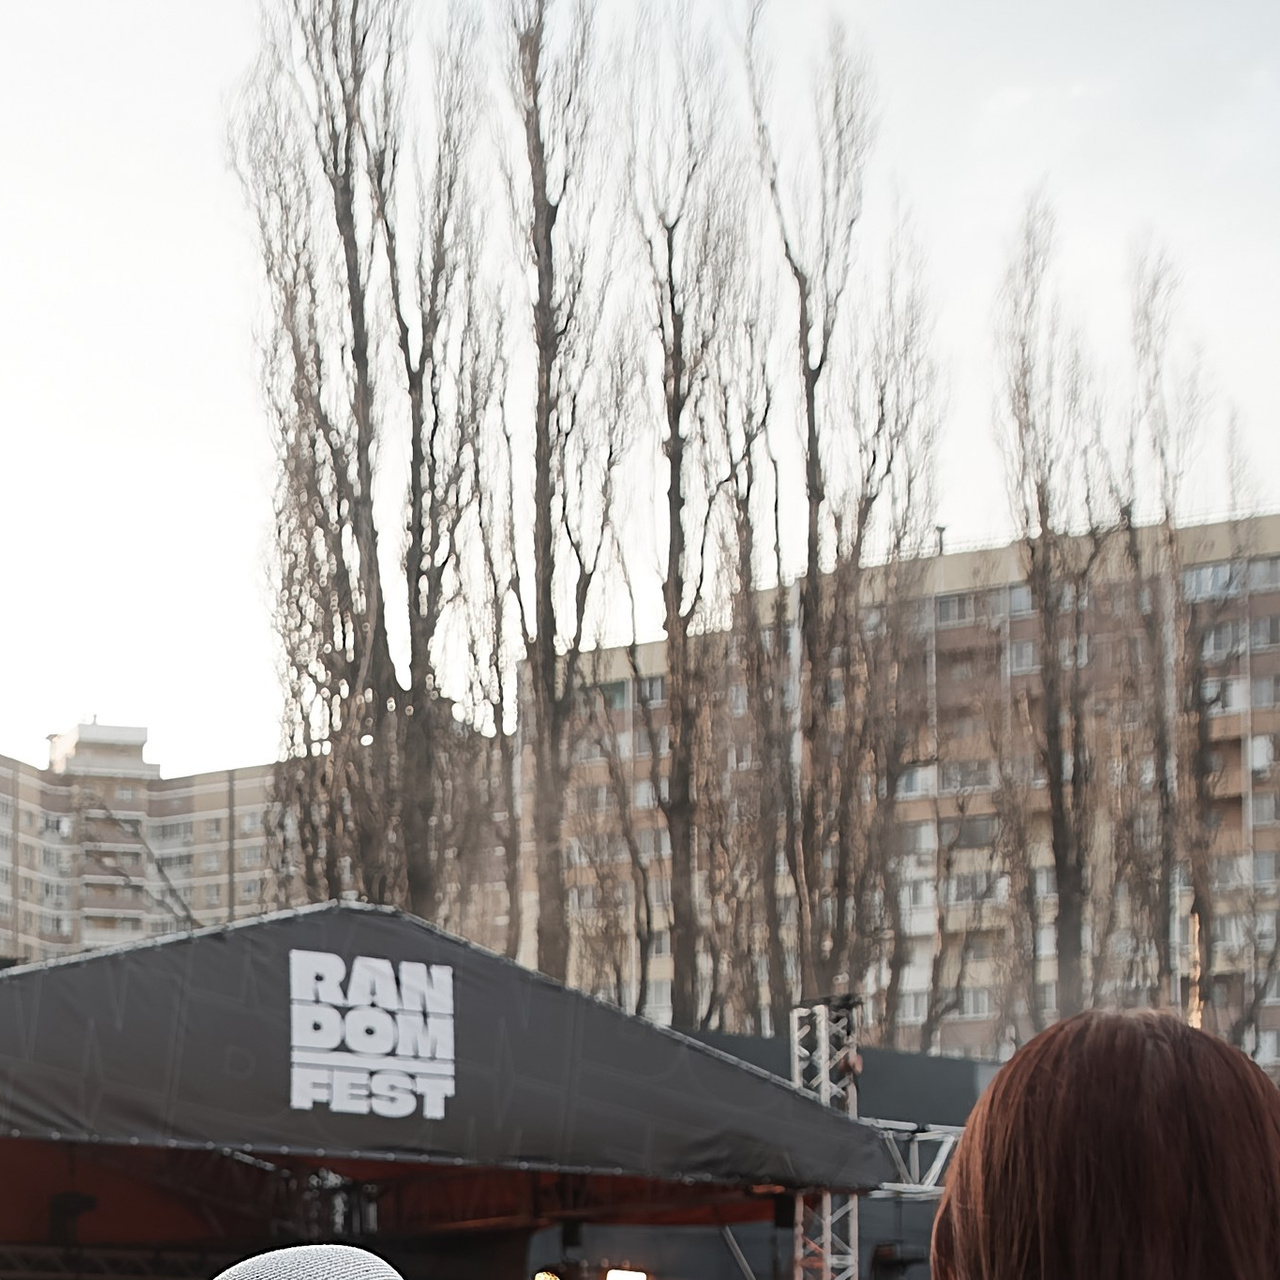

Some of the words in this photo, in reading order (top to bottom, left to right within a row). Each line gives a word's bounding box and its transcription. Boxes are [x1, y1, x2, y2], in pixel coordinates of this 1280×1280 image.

[289, 948, 454, 1015] RAN
[290, 1002, 455, 1060] DOM
[290, 1067, 455, 1120] FEST
